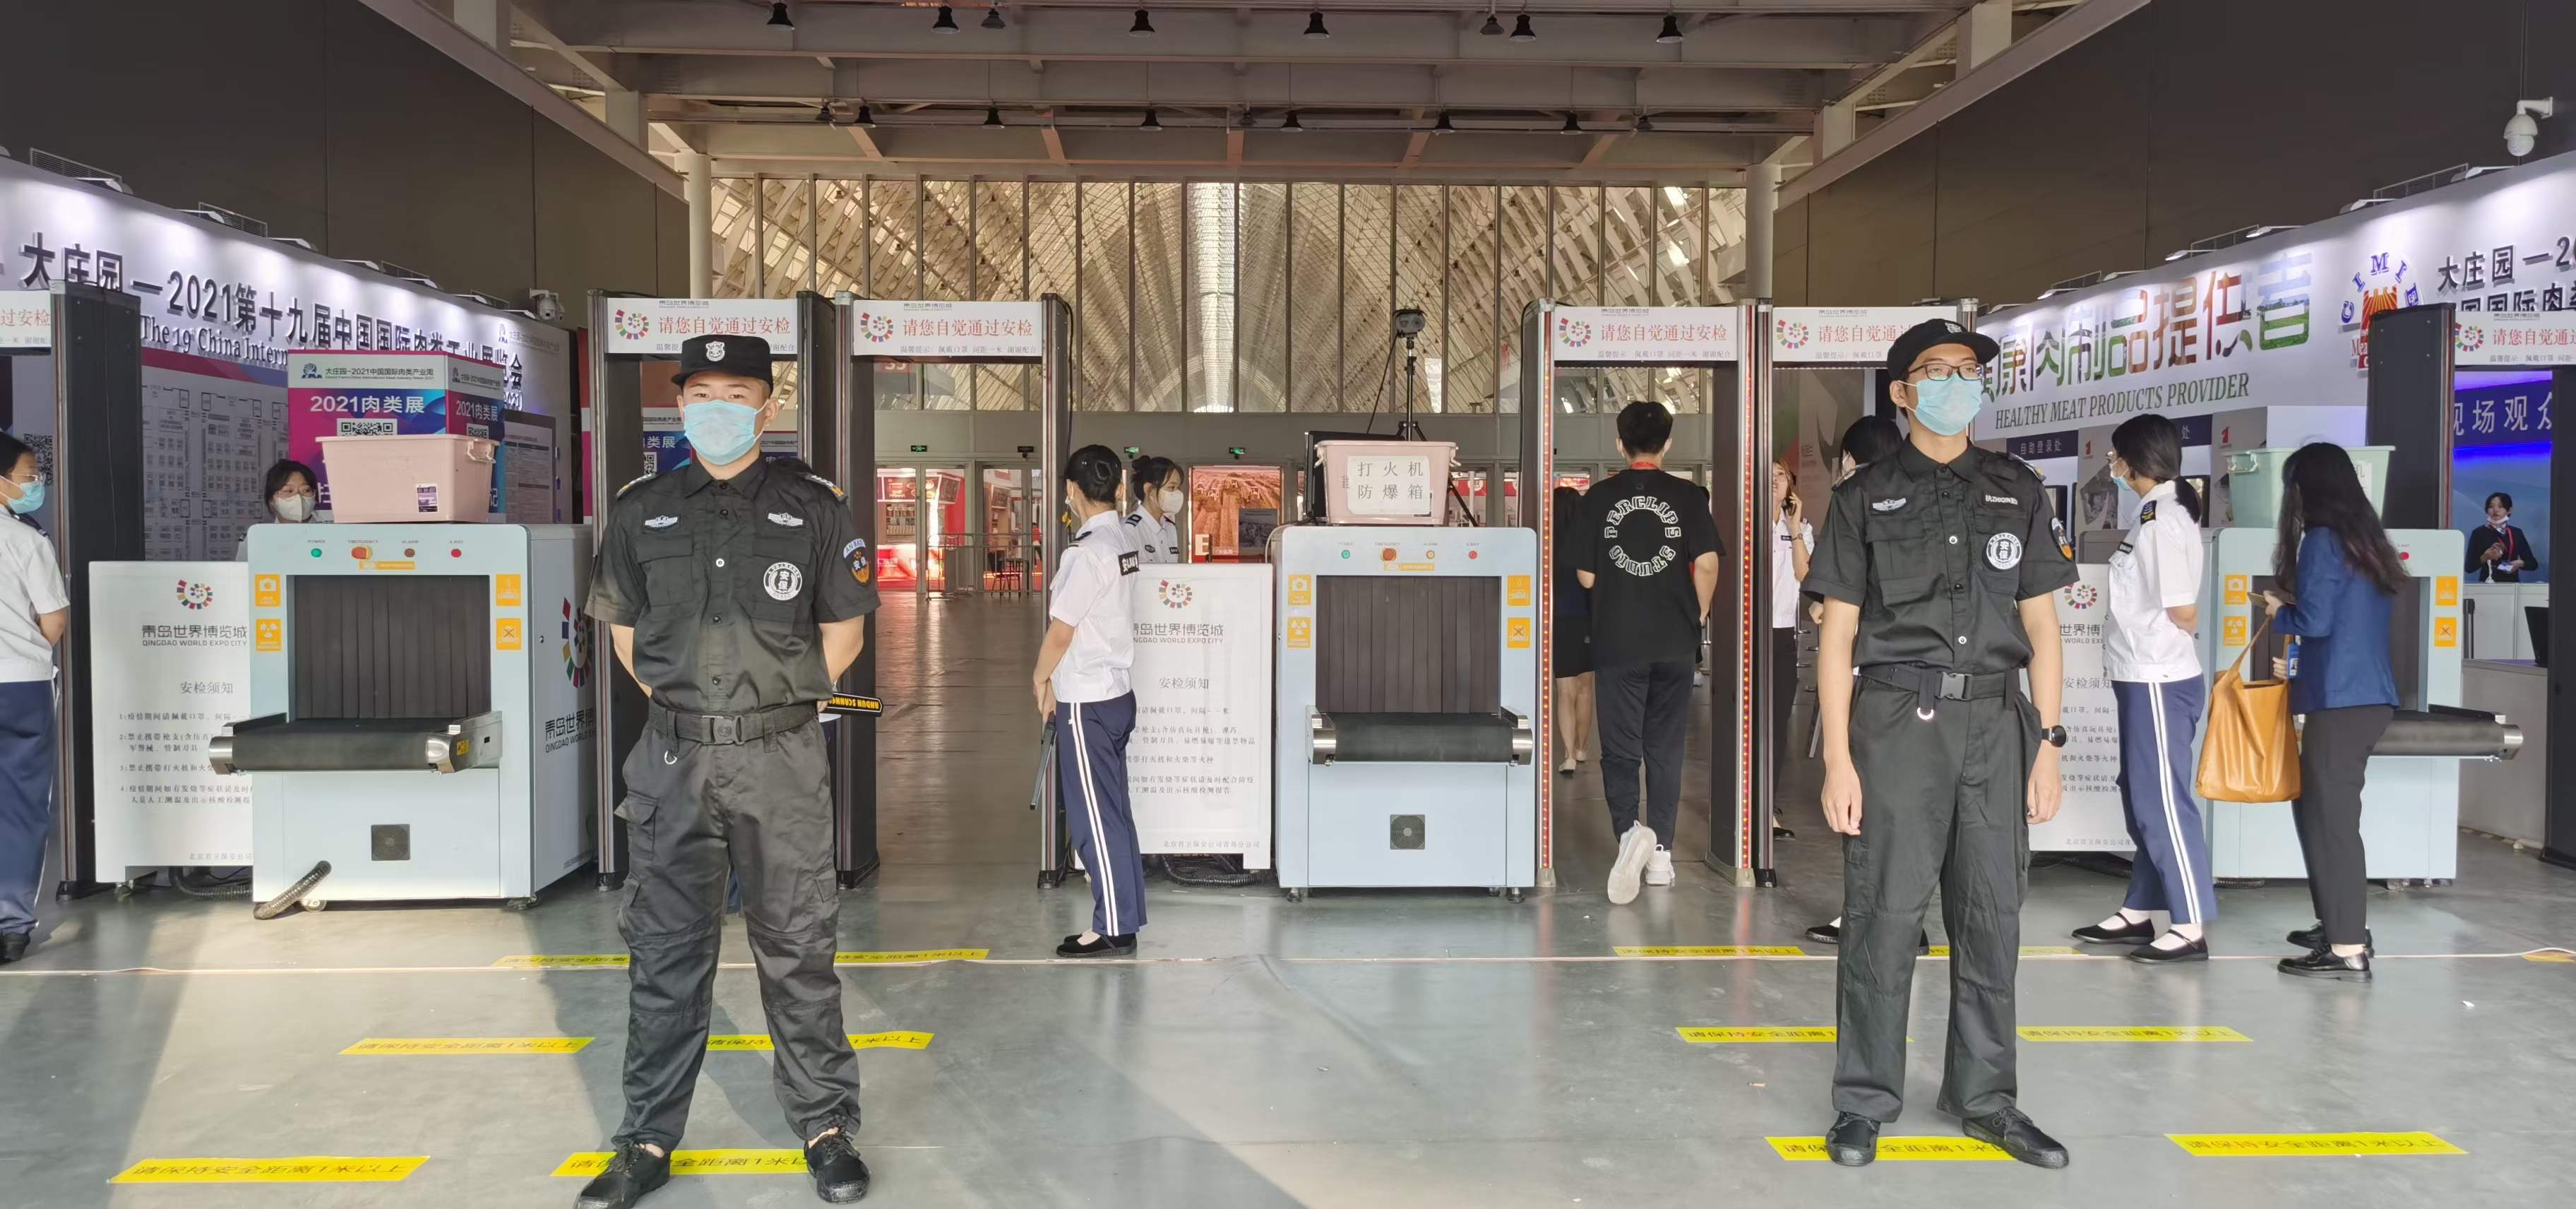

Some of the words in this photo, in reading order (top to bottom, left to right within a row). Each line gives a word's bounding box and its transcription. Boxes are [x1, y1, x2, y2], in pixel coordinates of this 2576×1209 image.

[658, 316, 791, 334] 请您自觉通过安检
[903, 318, 1033, 337] 请您自觉通过安检
[1601, 323, 1728, 341] 请您自觉通过安检
[141, 315, 170, 343] The
[198, 328, 242, 359] China
[310, 395, 424, 414] 2021肉类展
[1996, 402, 2049, 429] HEALTHY
[2051, 398, 2085, 419] MEAT
[2089, 384, 2164, 415] PRODUCTS
[2166, 371, 2250, 403] PROVIDER
[455, 399, 499, 422] 2021肉类展
[643, 435, 676, 449] 类展
[1609, 545, 1676, 577] STUDIO
[778, 570, 789, 591] 安保
[142, 624, 247, 638] 青岛世界博览城
[180, 681, 234, 695] 安检须知
[1159, 677, 1210, 690] 安检须知
[2188, 1139, 2446, 1148] 请保持安全距离1米以上
[133, 1165, 410, 1175] 请保持安全距离1米以上
